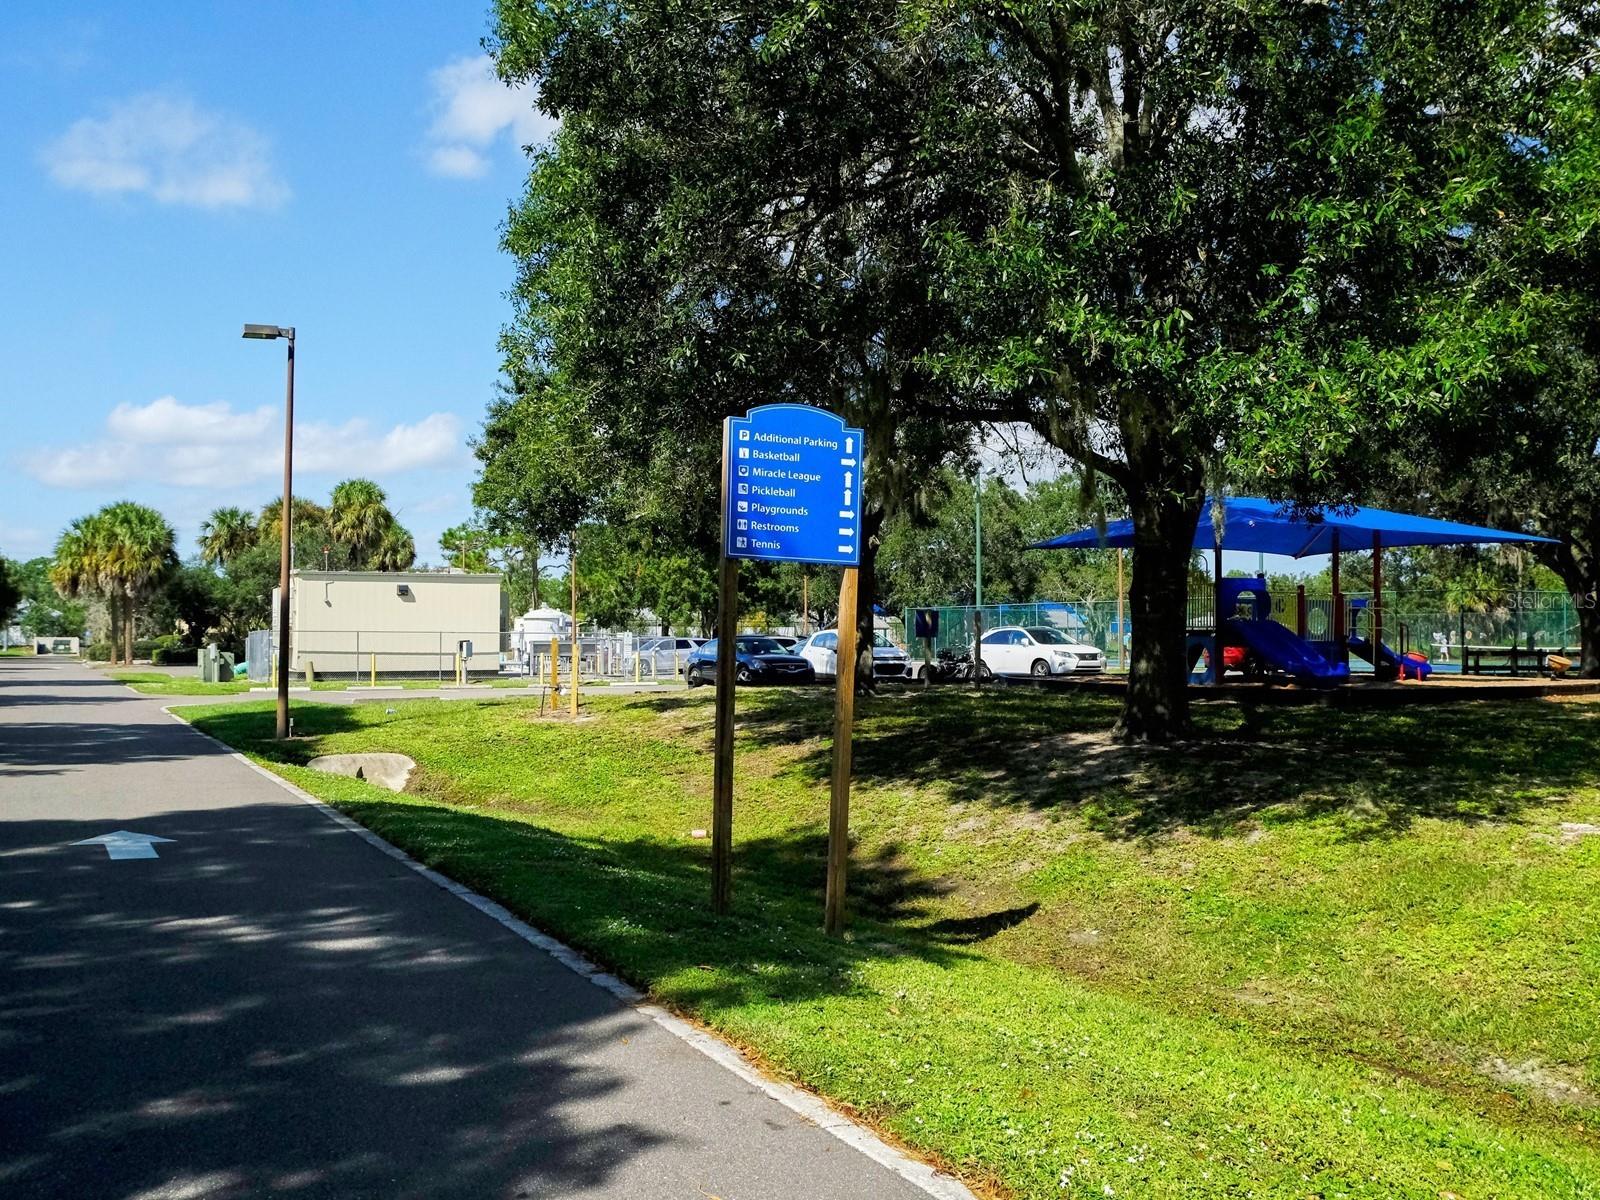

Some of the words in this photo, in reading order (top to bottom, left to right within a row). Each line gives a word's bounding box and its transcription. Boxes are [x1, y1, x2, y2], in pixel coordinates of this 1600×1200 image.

[753, 432, 801, 445] Additional
[803, 437, 838, 450] Parking
[752, 450, 800, 462] Basketball
[752, 467, 786, 478] Miracle
[788, 469, 821, 482] League
[751, 485, 796, 497] Pickleball
[751, 503, 808, 516] Playgrounds
[751, 521, 799, 533] Restrooms
[751, 538, 781, 549] Tennis
